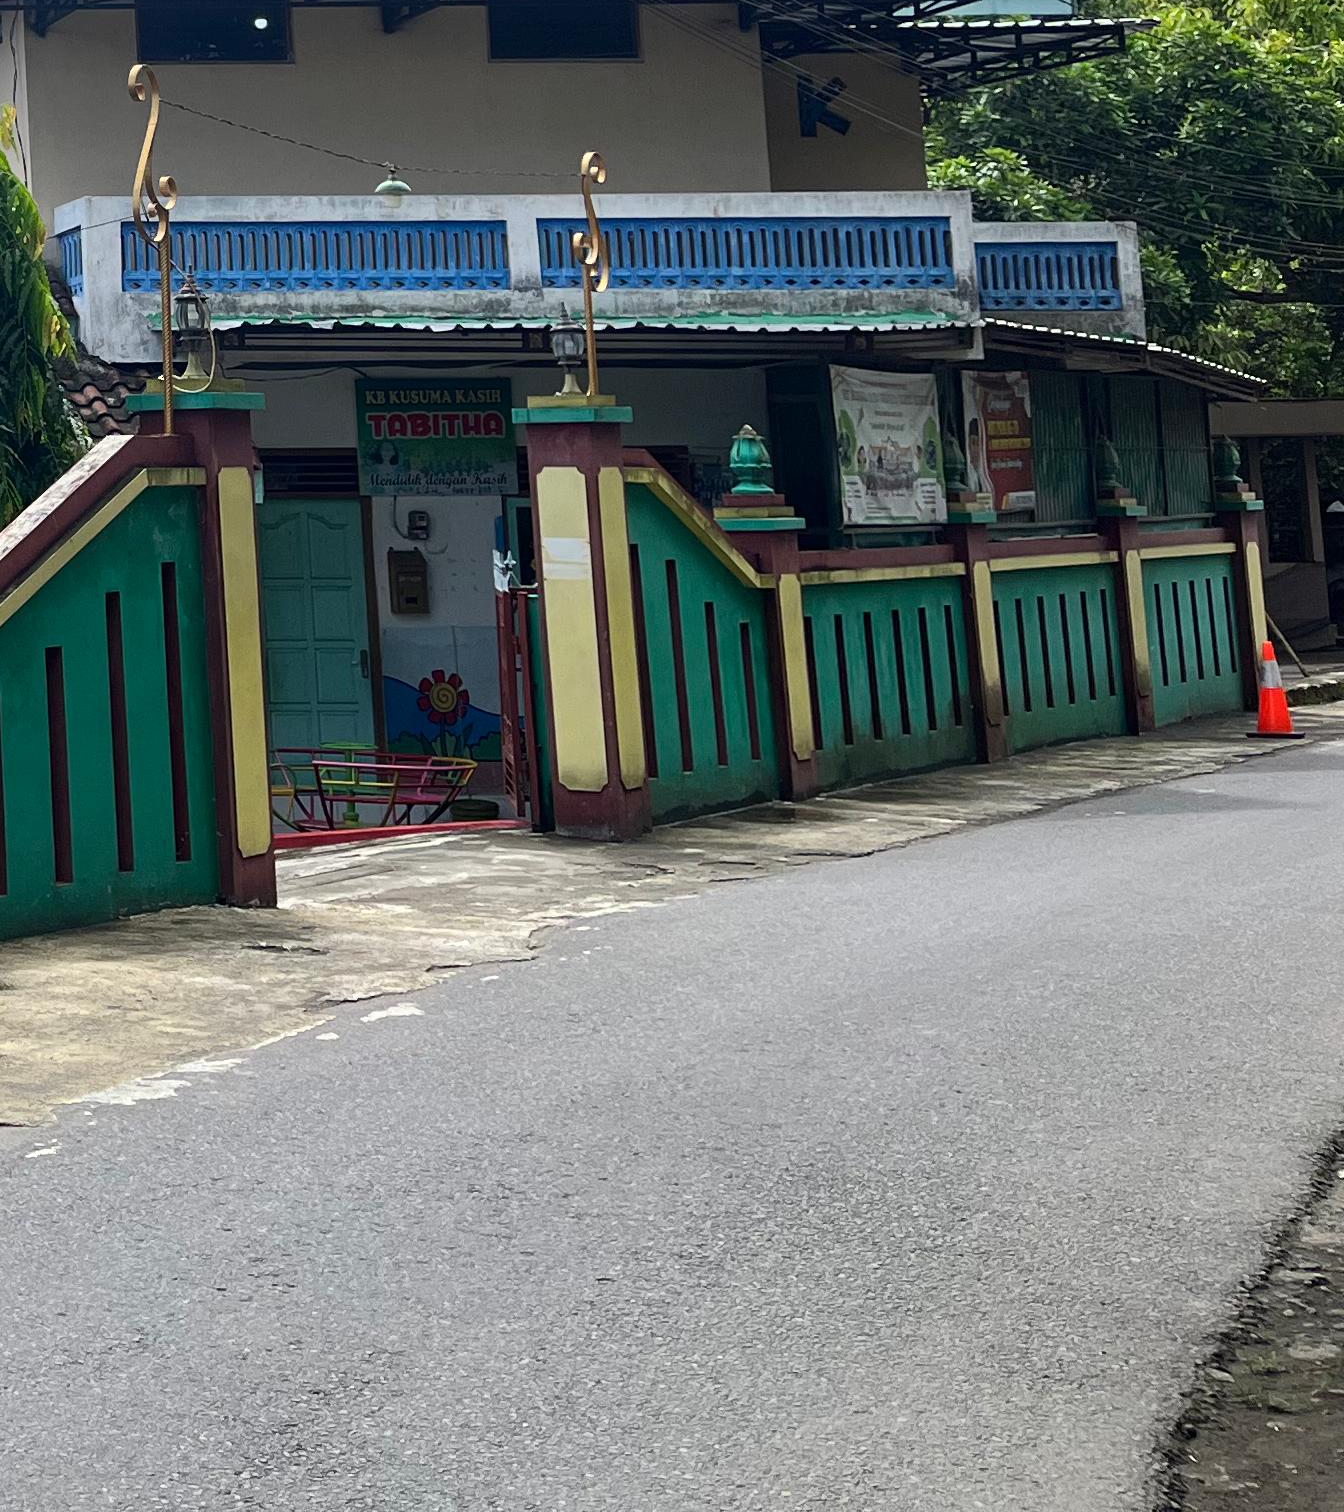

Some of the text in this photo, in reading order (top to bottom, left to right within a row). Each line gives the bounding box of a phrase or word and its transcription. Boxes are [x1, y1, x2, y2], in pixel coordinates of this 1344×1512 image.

[365, 389, 502, 404] KB KUSUMA KASIH
[366, 411, 505, 438] TABITHA
[368, 472, 508, 488] Mendidik dengan Kasih
